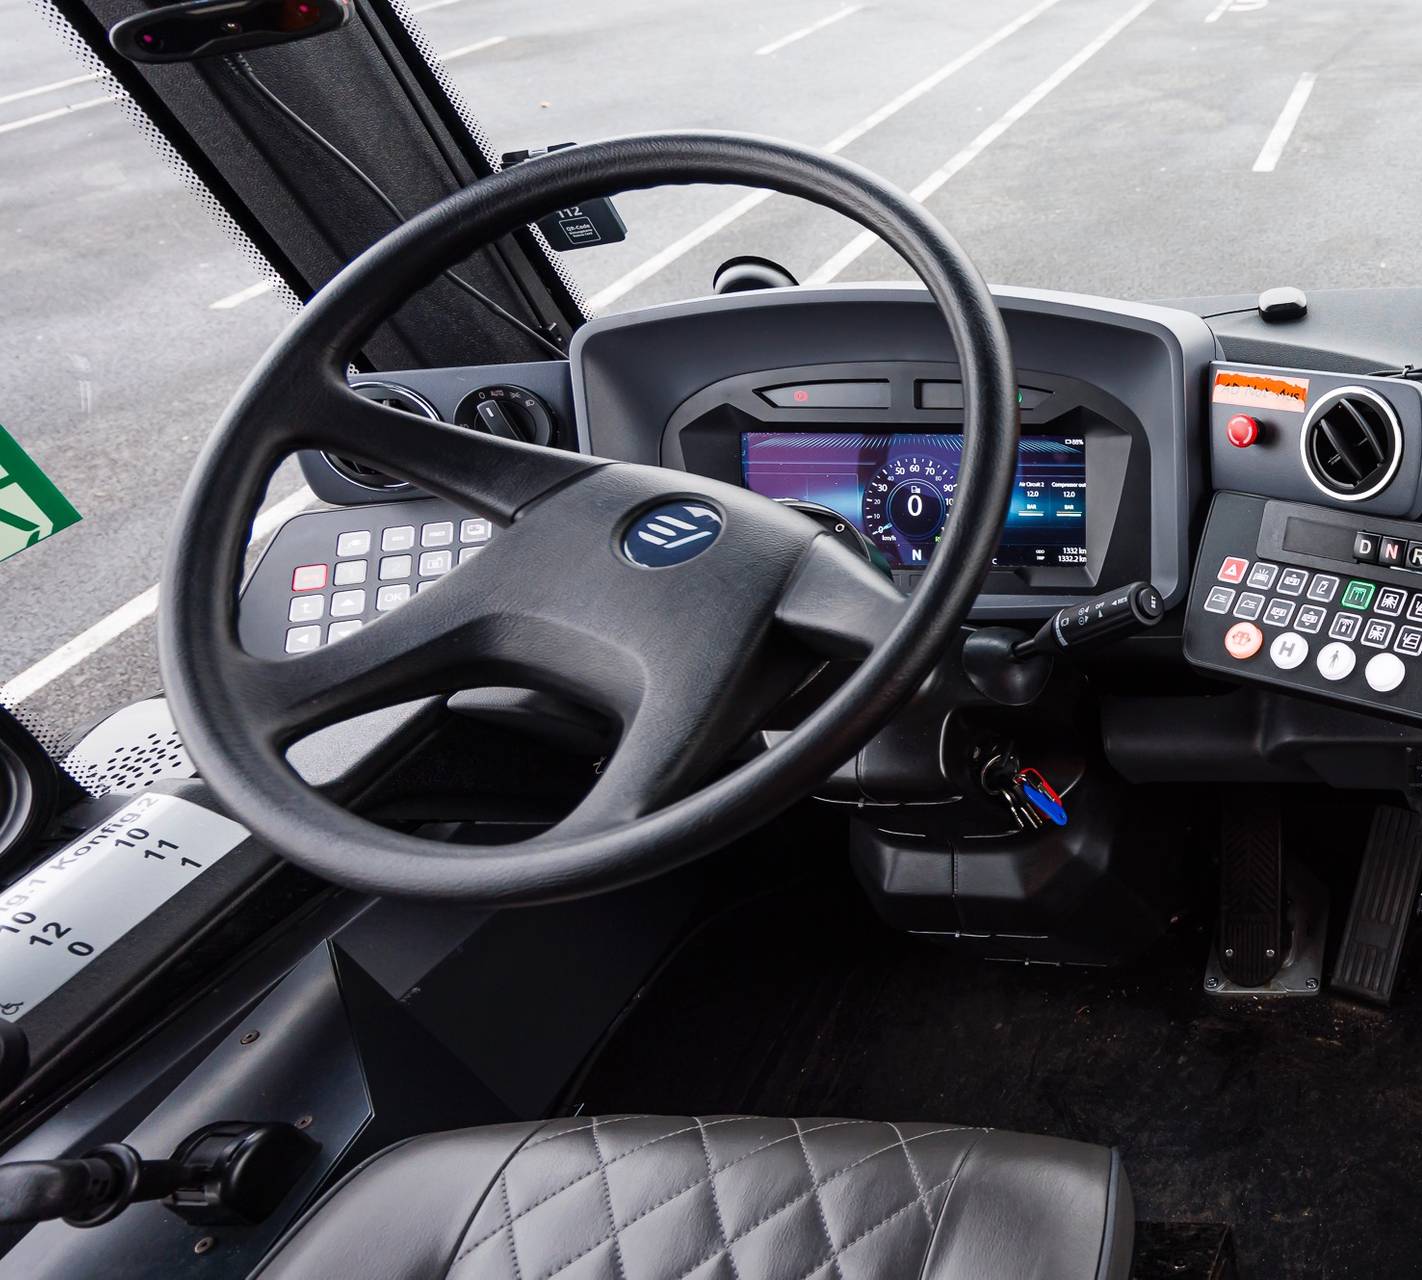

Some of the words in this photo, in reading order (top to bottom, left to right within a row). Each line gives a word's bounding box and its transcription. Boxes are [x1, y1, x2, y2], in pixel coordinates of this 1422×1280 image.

[895, 467, 905, 475] 50
[909, 464, 920, 472] 60
[925, 467, 935, 475] 70
[877, 484, 888, 492] 30
[943, 484, 953, 492] 90
[908, 495, 923, 516] 0
[912, 549, 922, 561] N
[1359, 539, 1372, 554] D
[1385, 544, 1398, 560] N
[384, 592, 402, 602] OK
[1278, 641, 1296, 657] H
[50, 796, 159, 870] Konfig.2
[115, 827, 150, 848] 10
[29, 921, 72, 946] 12
[144, 839, 180, 860] 11
[67, 941, 94, 957] 0
[181, 856, 203, 868] 1
